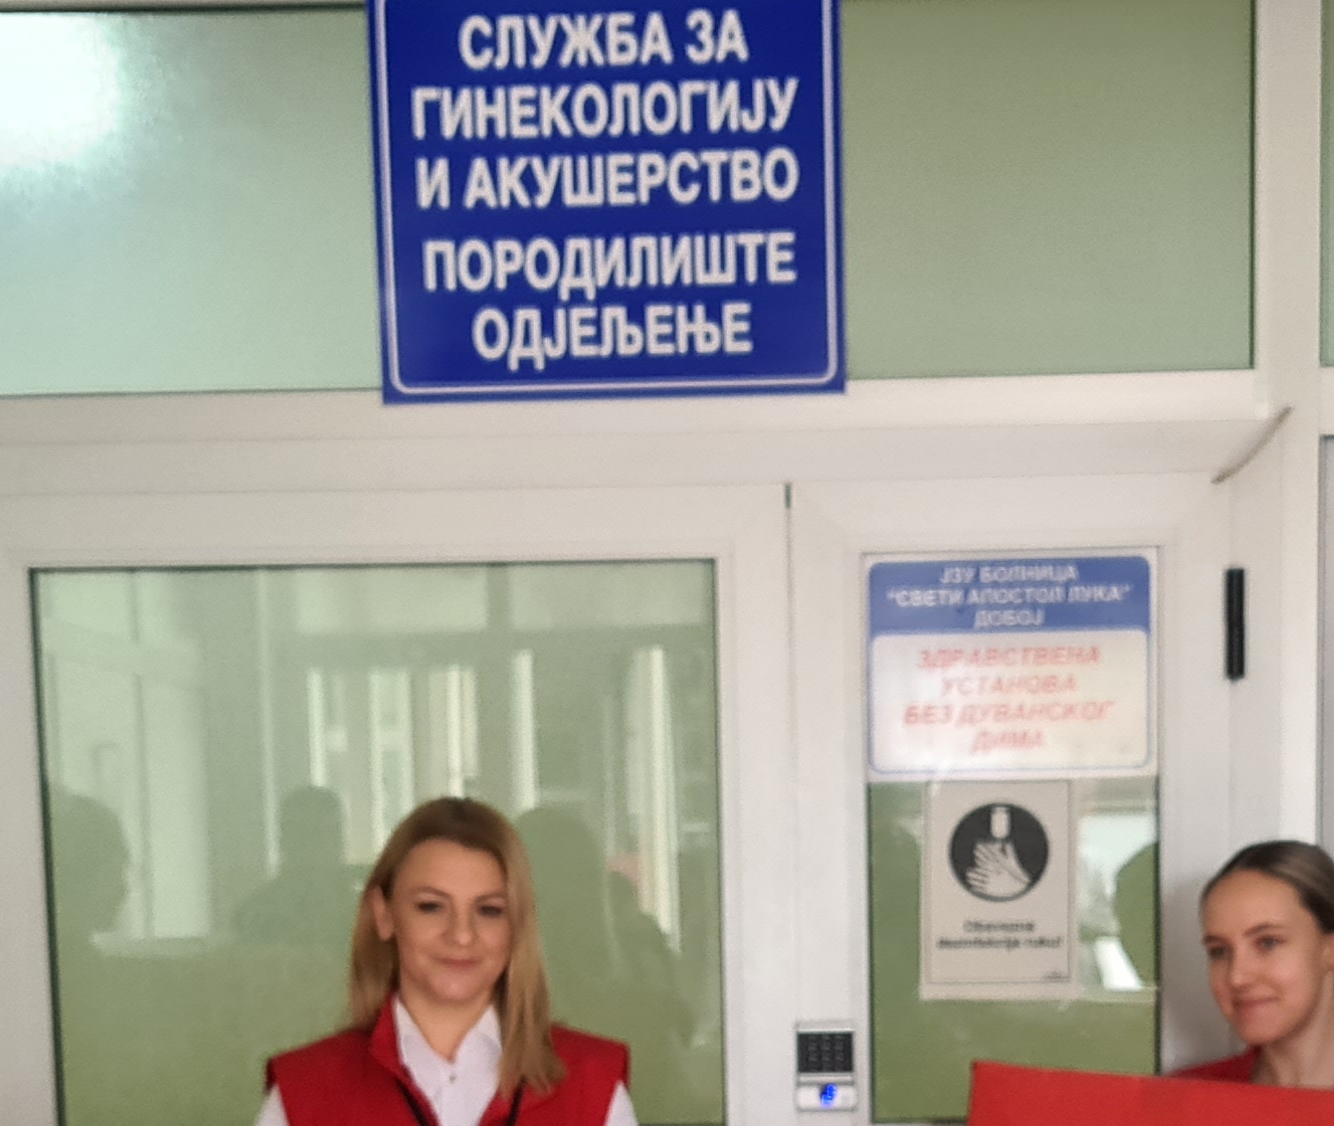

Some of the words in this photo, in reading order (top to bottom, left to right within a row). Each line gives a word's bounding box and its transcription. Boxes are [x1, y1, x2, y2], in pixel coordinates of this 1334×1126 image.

[458, 12, 673, 70] СЛУЖБА
[685, 9, 749, 64] ЗА
[411, 77, 800, 140] ГИНЕКОЛОГИЈУ
[415, 157, 450, 210] И
[463, 147, 800, 209] АКУШЕРСТВО
[422, 230, 798, 302] ПОРОДИЛИШТЕ
[472, 301, 753, 372] ОДЈЕЉЕЊЕ
[979, 563, 1080, 583] БОЛНИЦА
[967, 584, 1065, 604] АПОСТОЛ
[974, 609, 1046, 628] ДОБОЈ
[918, 646, 1102, 670] ЗДРАВСТВЕНА
[940, 674, 1079, 696] УСТАНОВА
[903, 704, 953, 725] БЕЗ
[955, 699, 1115, 727] ДУВАНСКОГ
